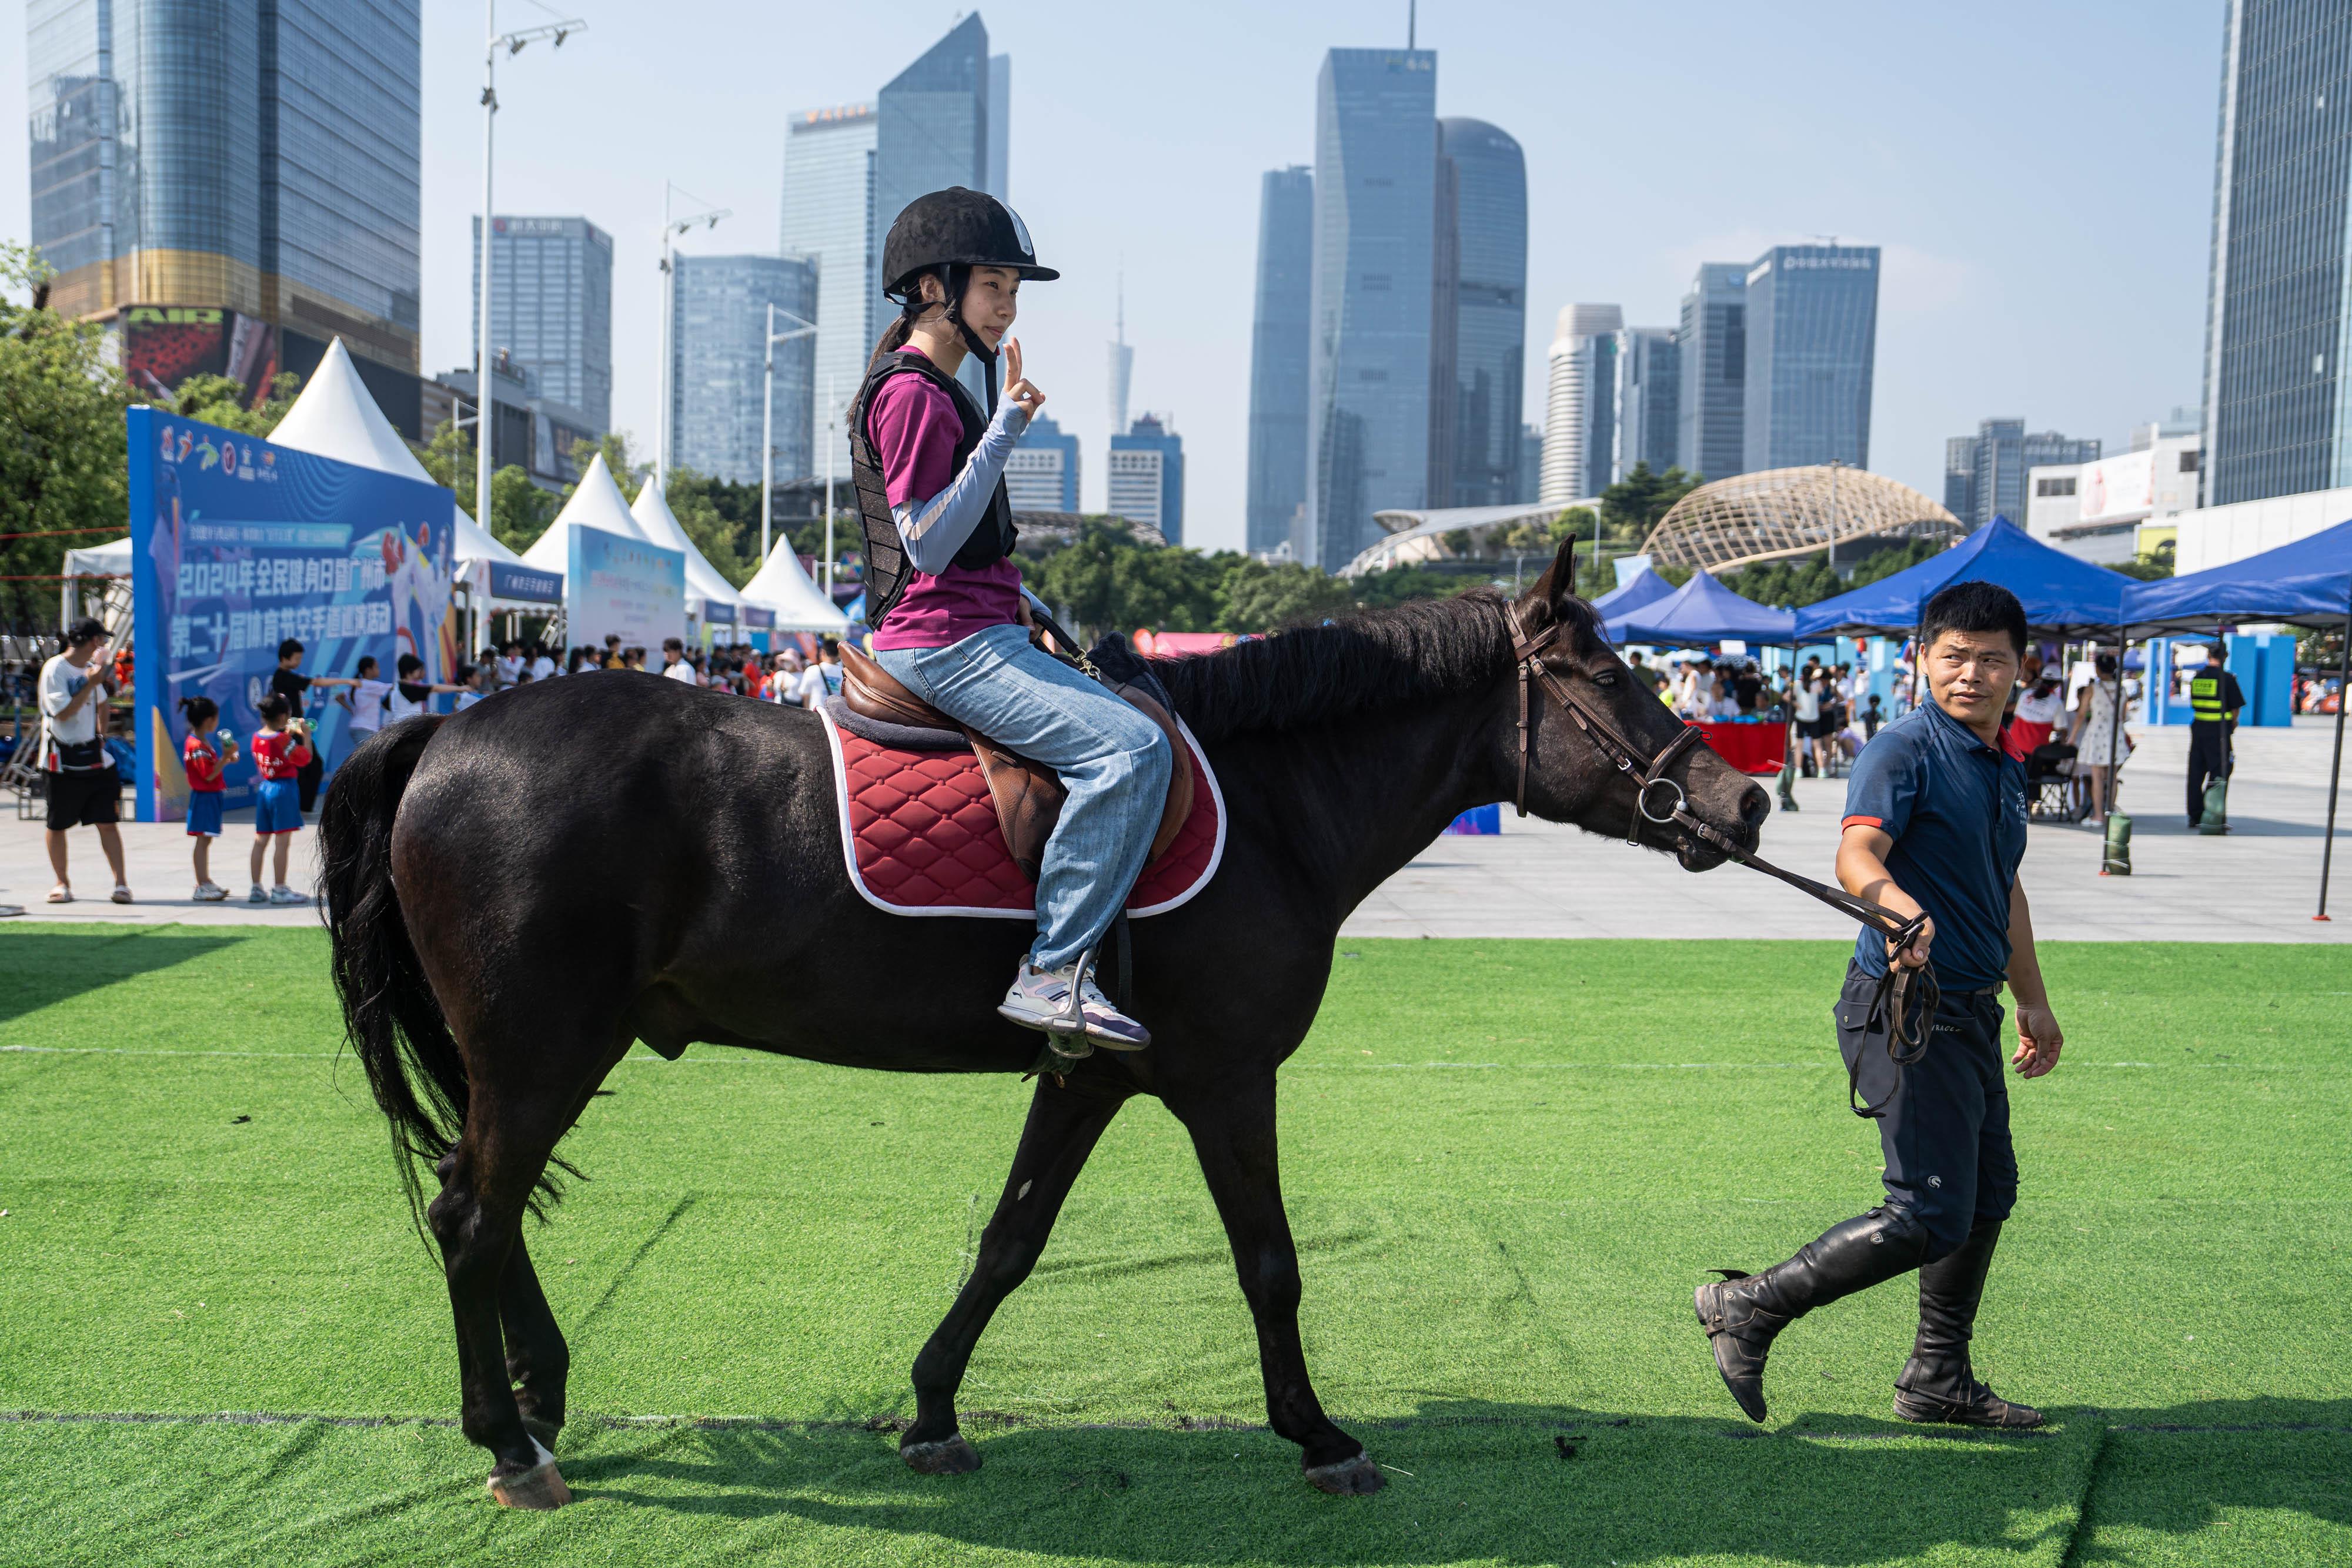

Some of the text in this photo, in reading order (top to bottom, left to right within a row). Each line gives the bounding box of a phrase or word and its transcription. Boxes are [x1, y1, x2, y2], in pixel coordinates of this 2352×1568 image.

[128, 307, 223, 322] AIR
[178, 557, 385, 597] 2024年全民健身日暨广州市
[172, 601, 391, 657] 第二十届体育节空手道巡演活动
